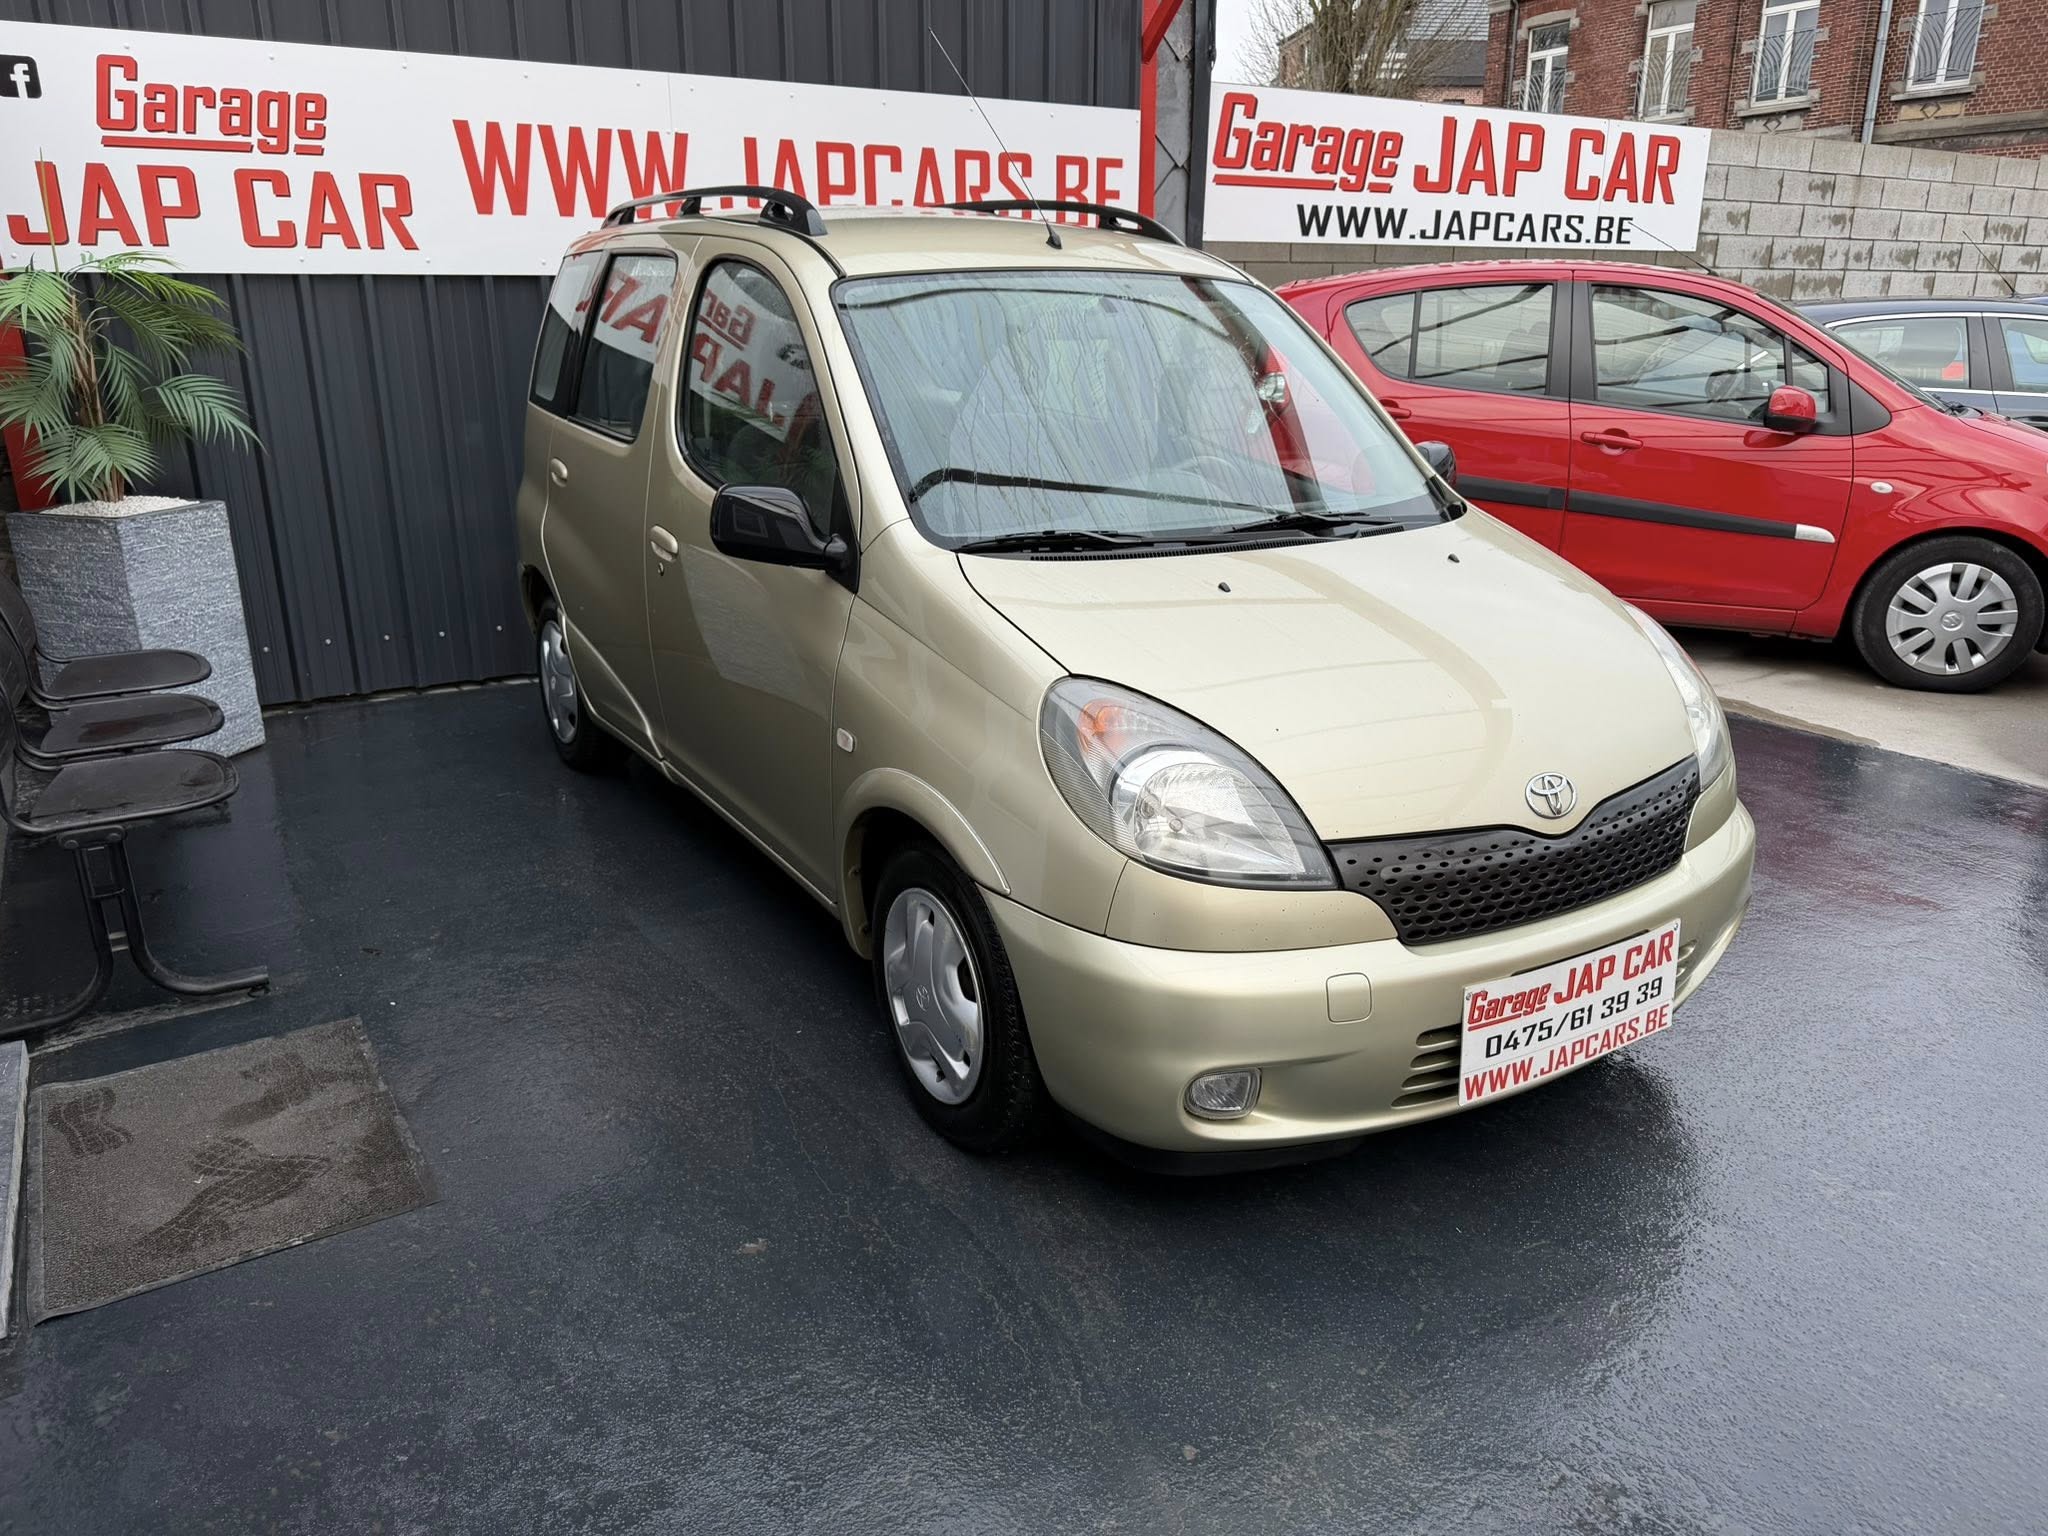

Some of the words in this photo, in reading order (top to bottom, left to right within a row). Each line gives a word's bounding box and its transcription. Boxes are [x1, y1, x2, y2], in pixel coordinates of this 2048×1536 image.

[96, 54, 327, 154] Garage
[1213, 92, 1403, 192] Garage
[1413, 116, 1545, 197] JAP
[1564, 127, 1681, 205] CAR
[6, 160, 201, 247] JAP
[234, 167, 420, 251] CAR
[453, 119, 1123, 228] WWW.JAPCARSBE
[1297, 203, 1634, 245] WWW.JAPCARS.BE
[1467, 982, 1551, 1026] Garage
[1554, 955, 1616, 1004] JAP
[1623, 930, 1674, 980] CAR
[1485, 1004, 1593, 1058] 0475/61
[1601, 990, 1630, 1019] 39
[1636, 976, 1663, 1005] 39
[1464, 1004, 1670, 1100] WWW.JAPCARS.BE
